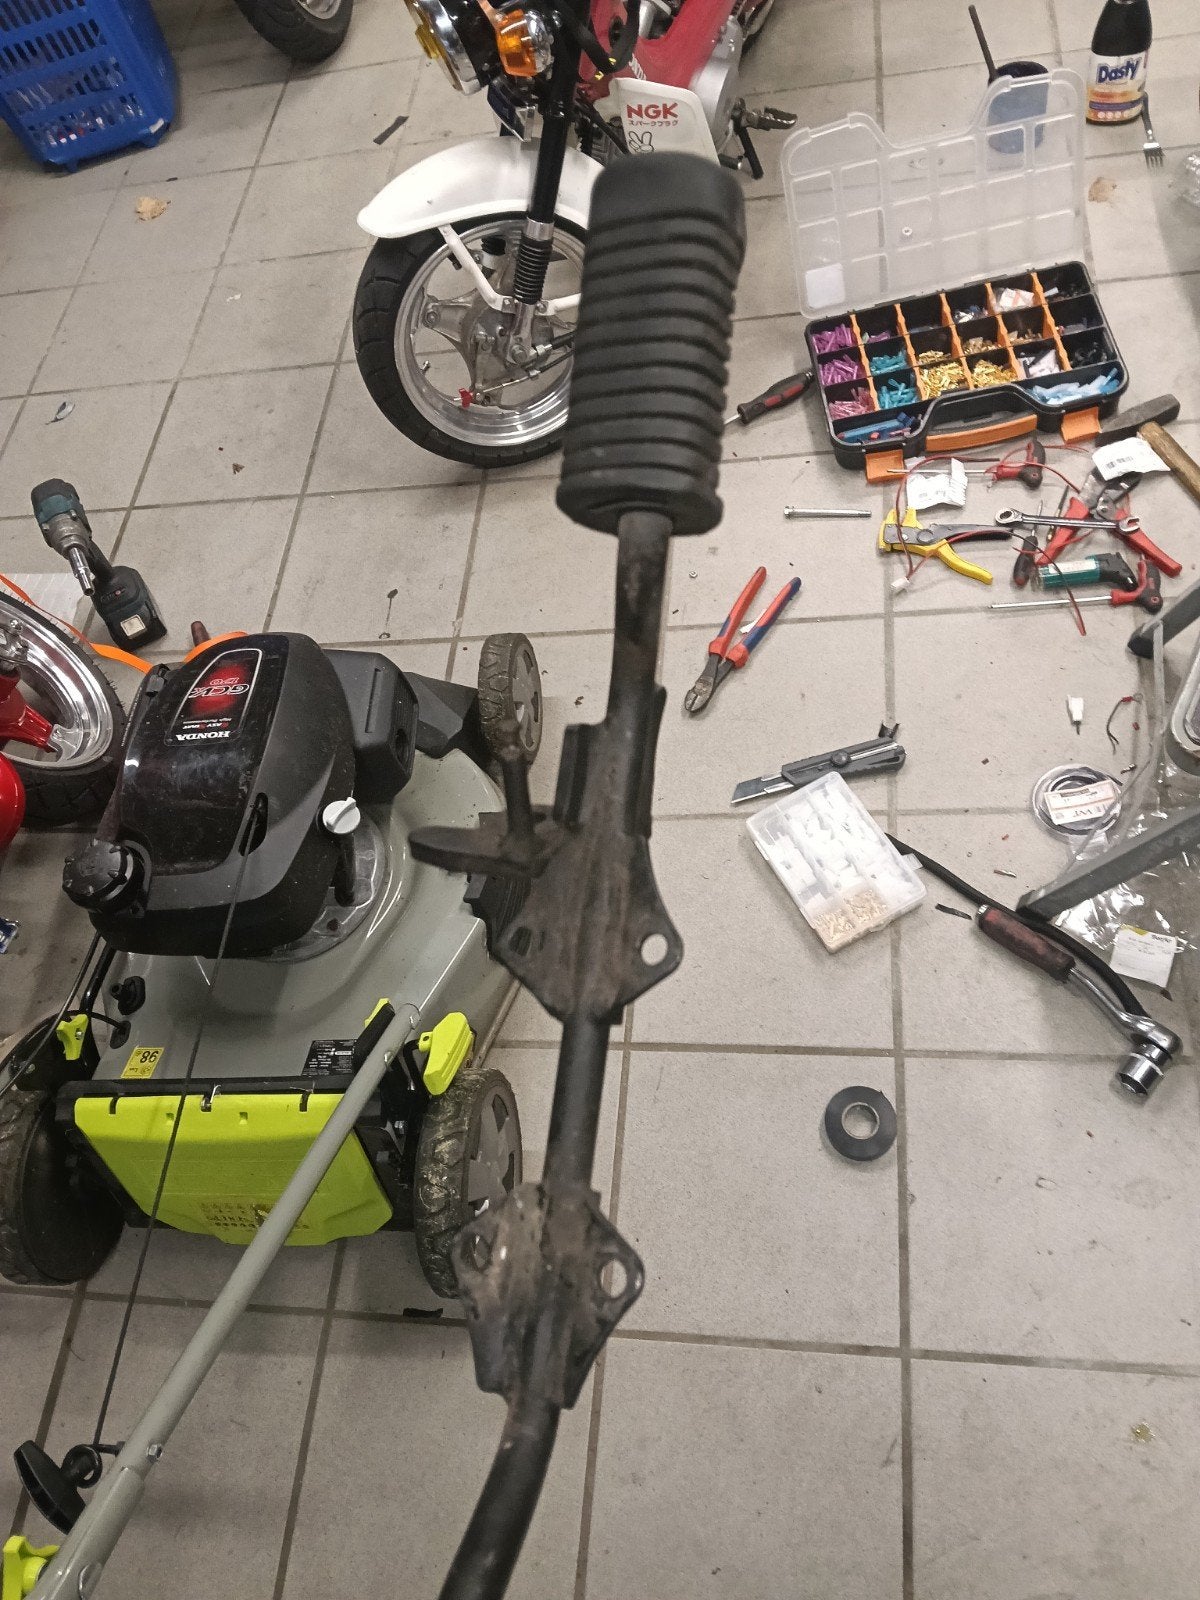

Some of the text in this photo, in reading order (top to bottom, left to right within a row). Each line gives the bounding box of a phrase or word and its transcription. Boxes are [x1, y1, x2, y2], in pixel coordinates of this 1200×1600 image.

[1097, 57, 1141, 83] Dasty
[626, 102, 678, 119] NGK
[176, 730, 231, 741] HONDA
[139, 1050, 159, 1064] 98
